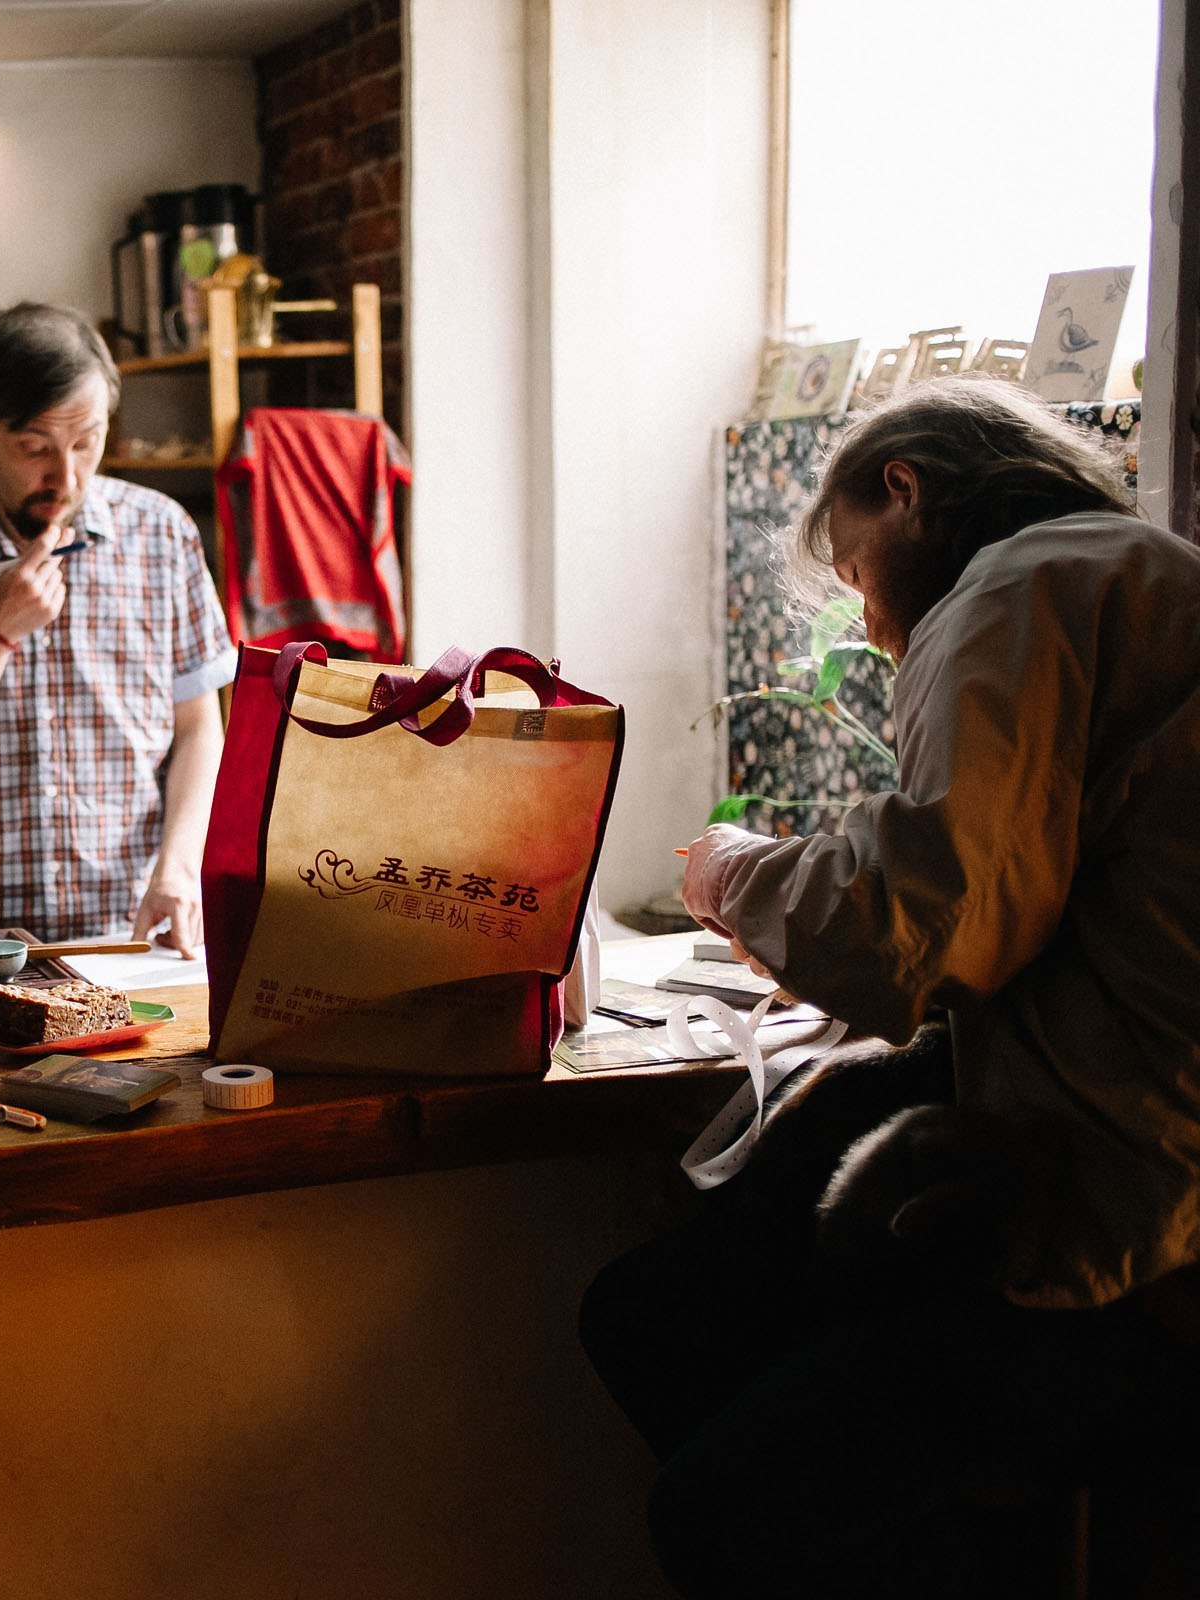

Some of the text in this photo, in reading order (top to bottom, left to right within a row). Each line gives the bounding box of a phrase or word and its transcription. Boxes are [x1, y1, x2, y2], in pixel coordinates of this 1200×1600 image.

[373, 857, 540, 913] 孟乔茶苑
[374, 889, 523, 944] 凤凰单枞专卖
